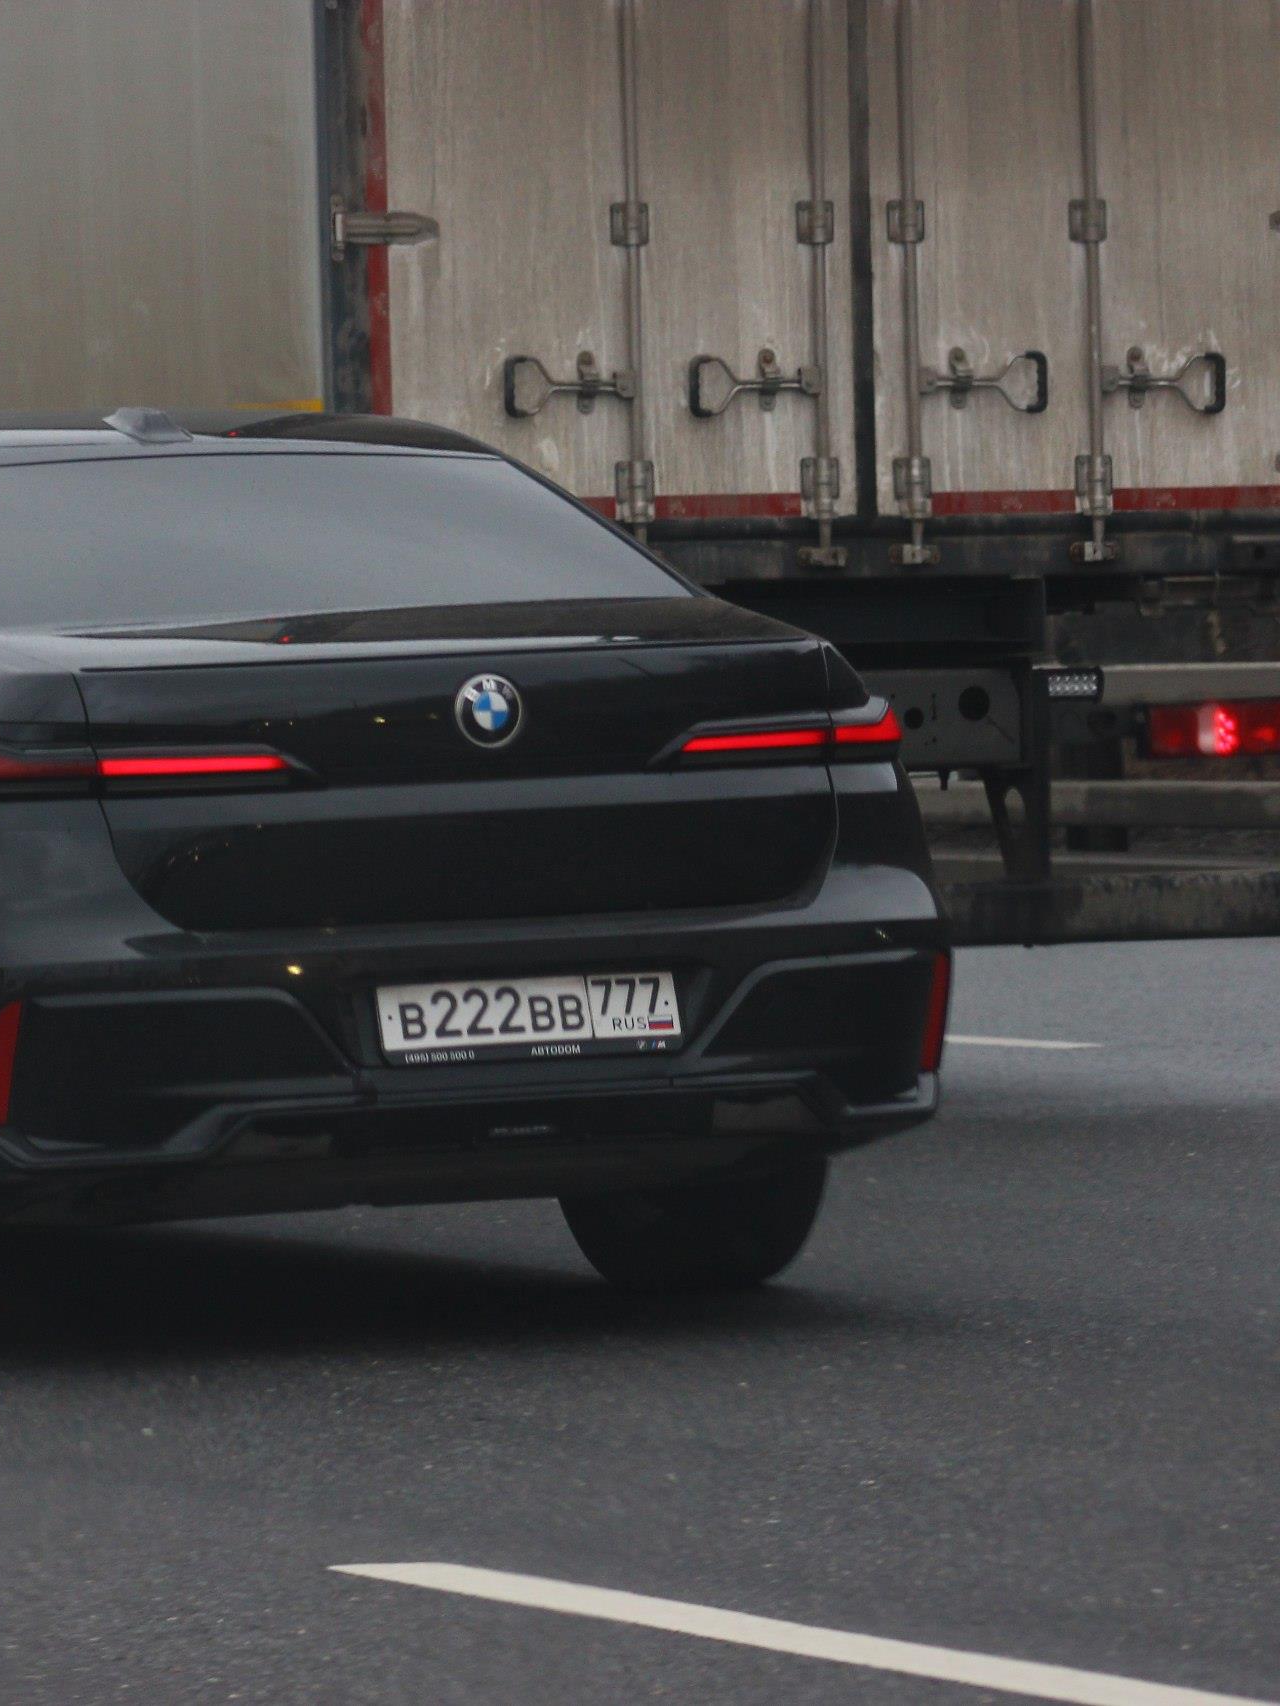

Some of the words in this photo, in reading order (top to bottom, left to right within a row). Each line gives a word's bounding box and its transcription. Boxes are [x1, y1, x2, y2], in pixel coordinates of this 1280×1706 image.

[399, 986, 585, 1039] B222BB
[591, 977, 660, 1015] 777
[612, 1016, 647, 1031] RUS
